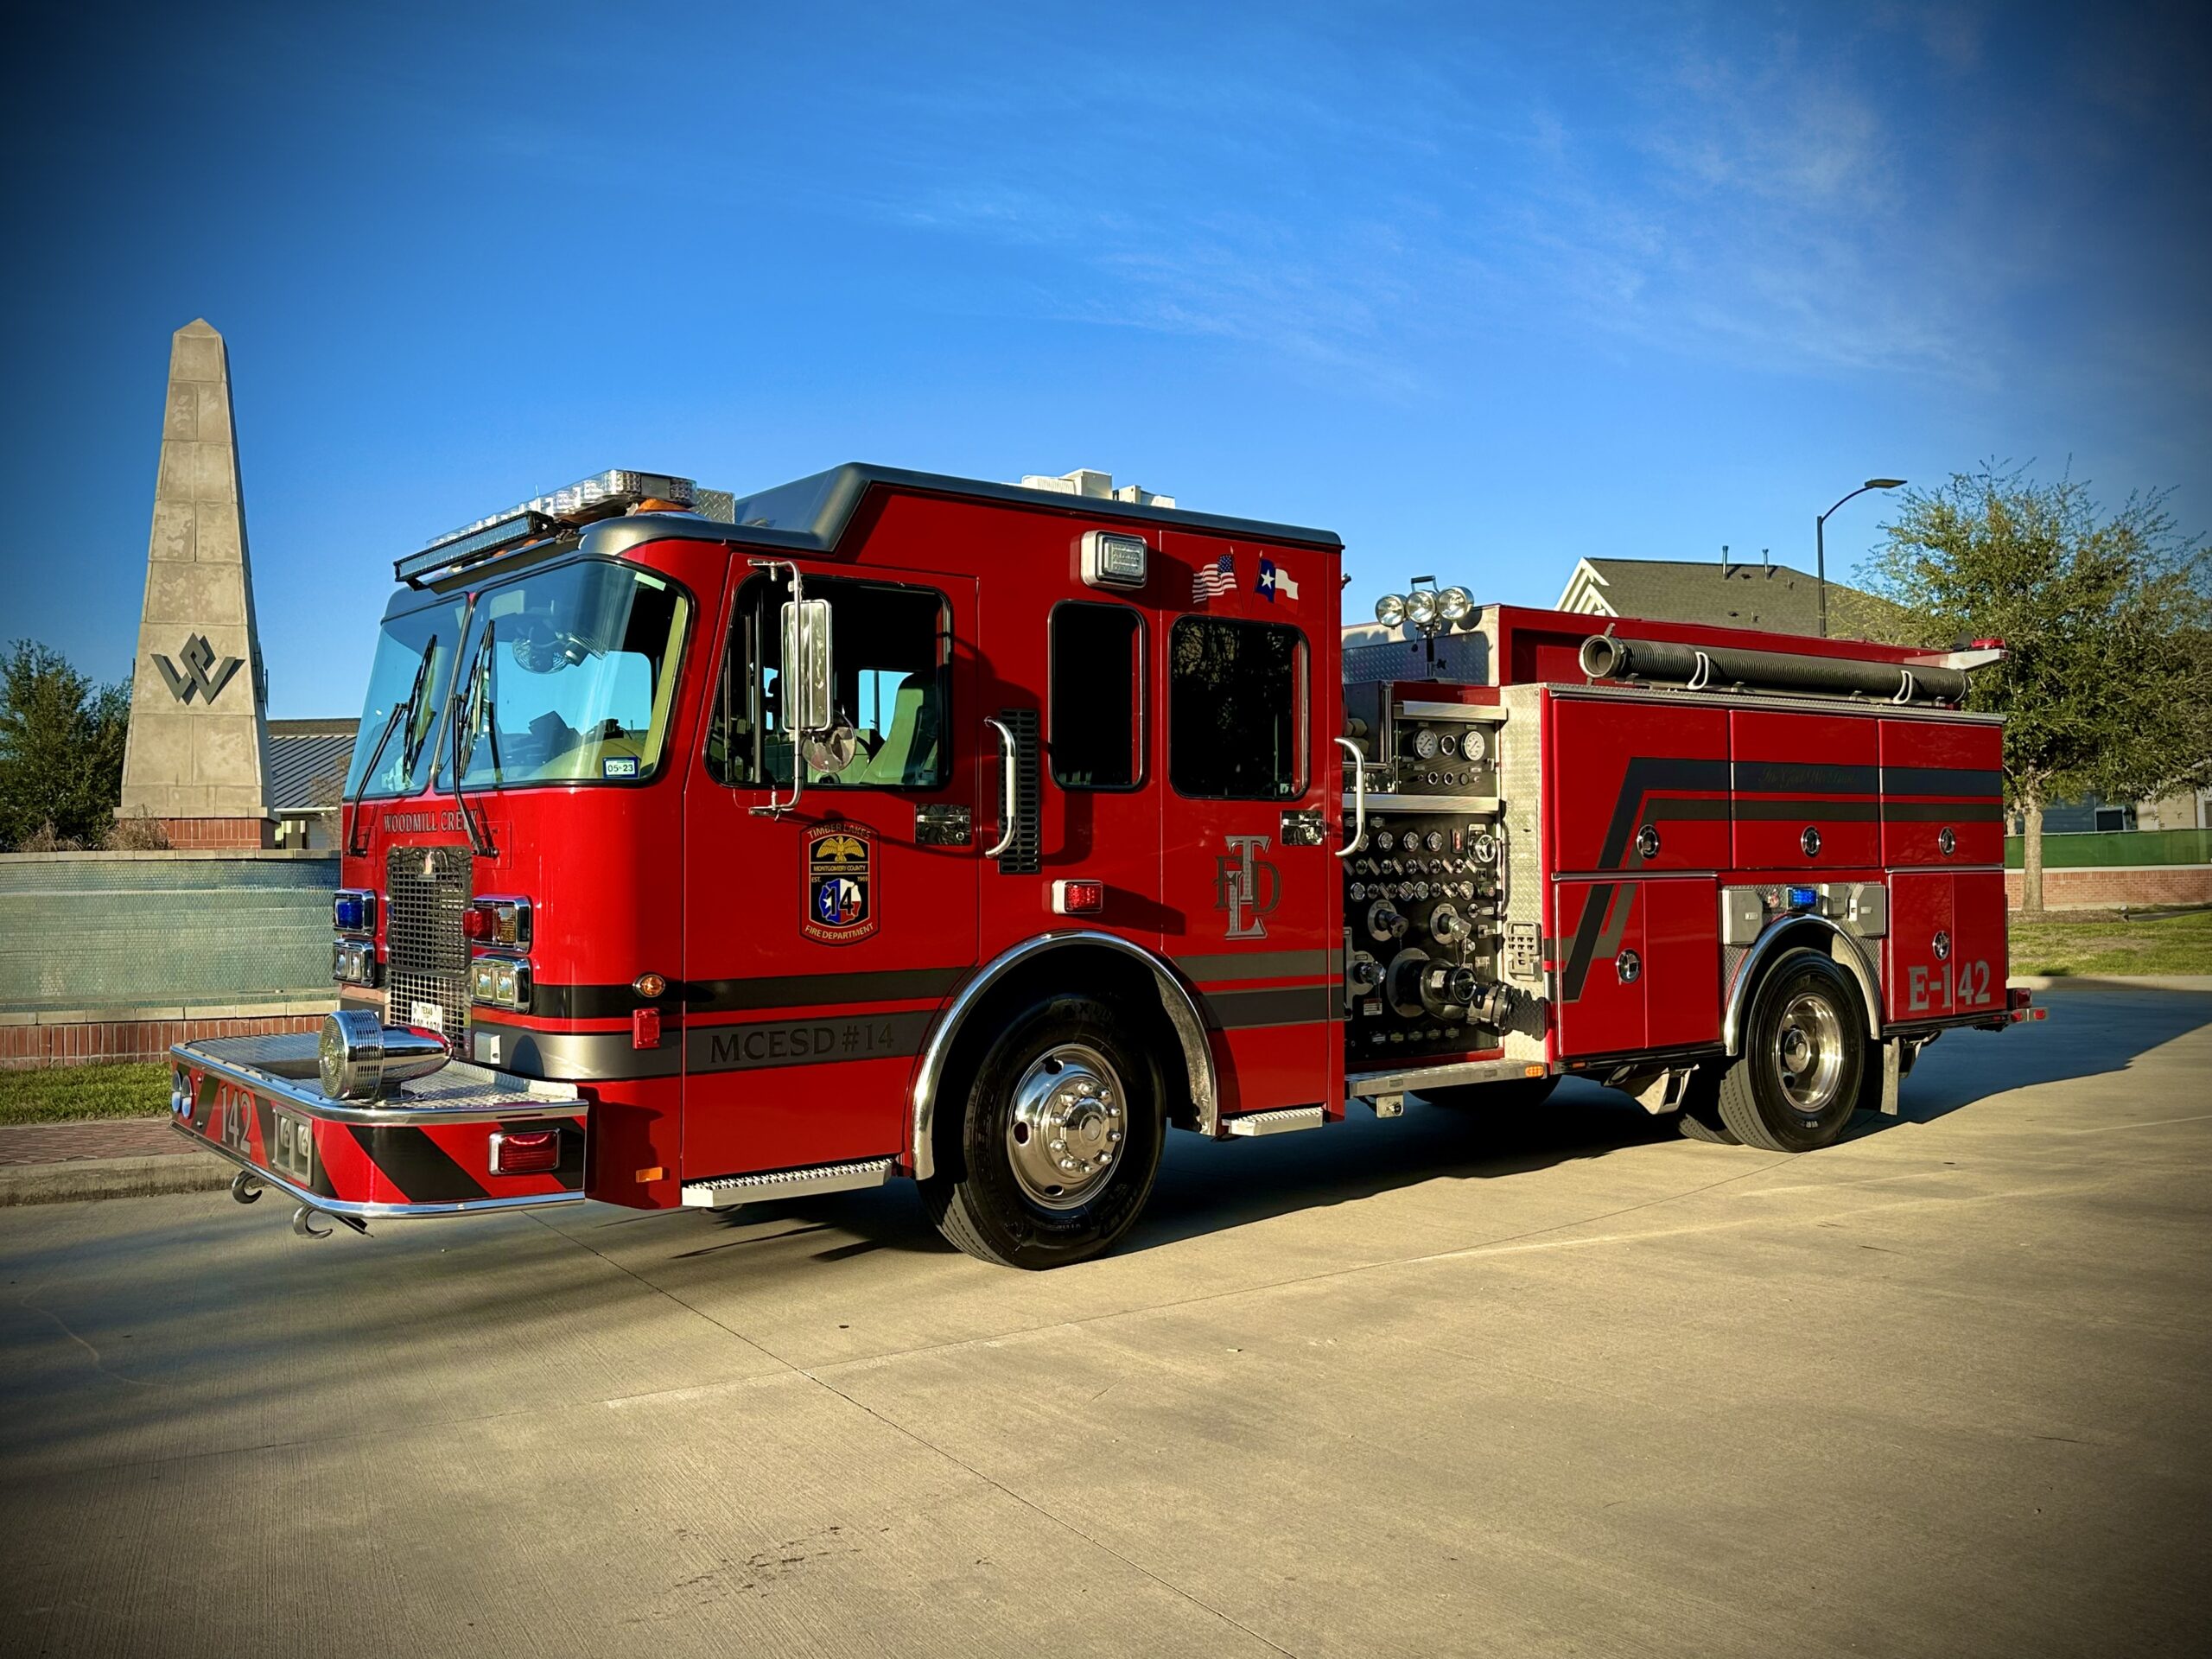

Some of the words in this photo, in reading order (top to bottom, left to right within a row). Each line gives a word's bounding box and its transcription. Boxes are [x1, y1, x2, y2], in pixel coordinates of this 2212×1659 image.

[384, 812, 437, 833] WOODMILL
[807, 823, 842, 840] TIMBER
[843, 823, 872, 840] LAKES
[826, 886, 855, 917] 14
[804, 925, 823, 938] FIRE
[822, 922, 874, 940] DEPARTMENT
[1908, 960, 1991, 1011] E-142
[709, 1027, 836, 1064] MCESD
[842, 1022, 895, 1052] #14
[221, 1086, 251, 1154] 142
